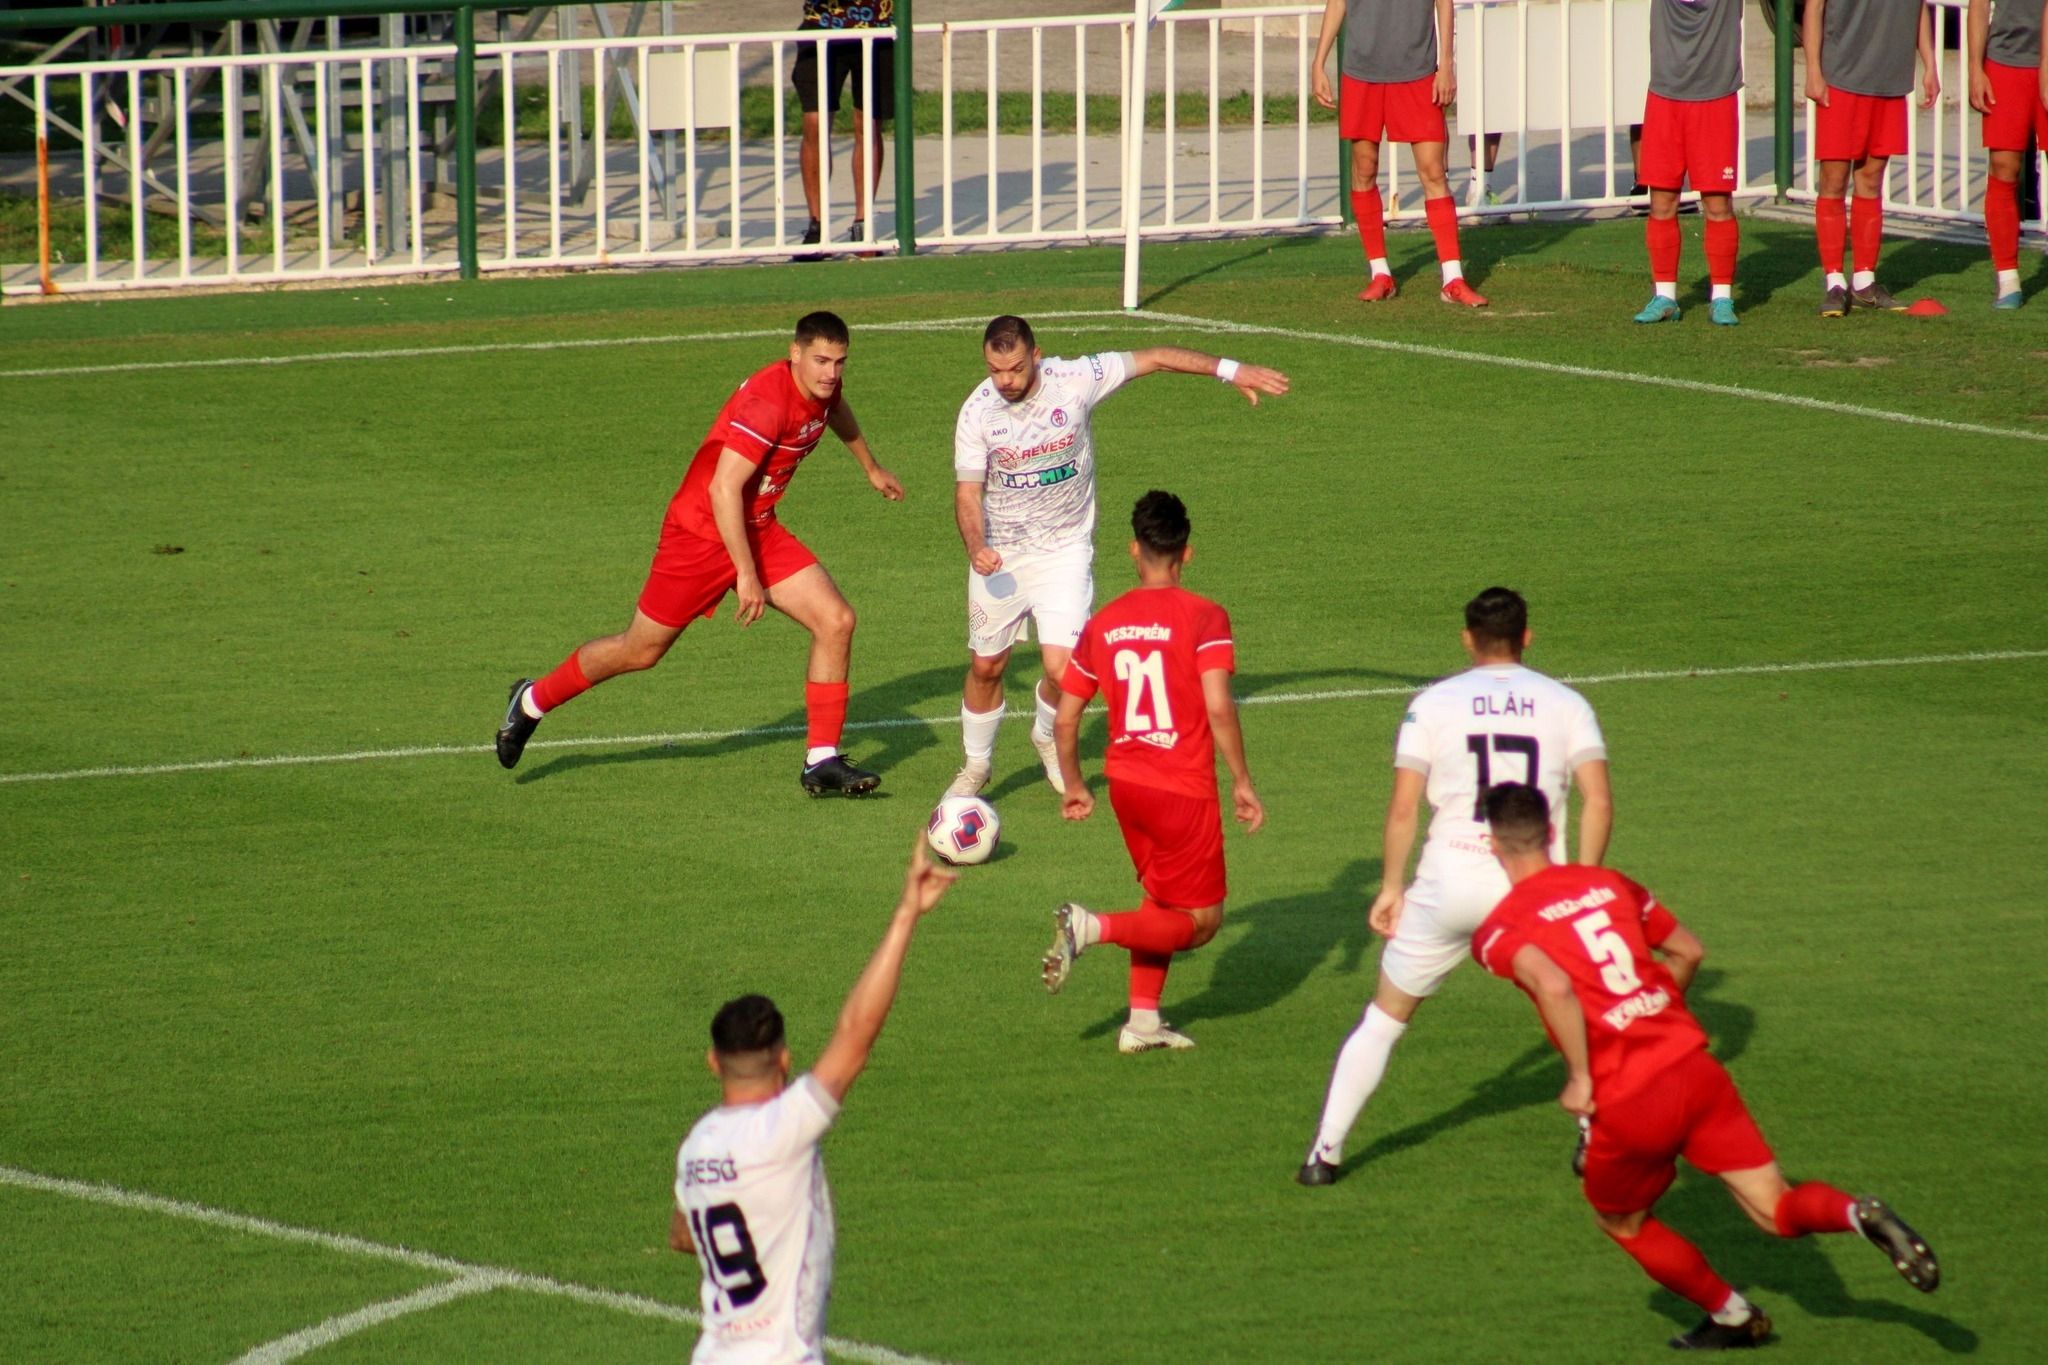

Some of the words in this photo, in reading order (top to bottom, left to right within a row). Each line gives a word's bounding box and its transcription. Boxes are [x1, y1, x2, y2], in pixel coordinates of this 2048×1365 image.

[1113, 649, 1174, 732] 21
[1472, 690, 1535, 718] OLÁH
[1571, 908, 1643, 996] 5
[690, 1201, 768, 1312] 19
